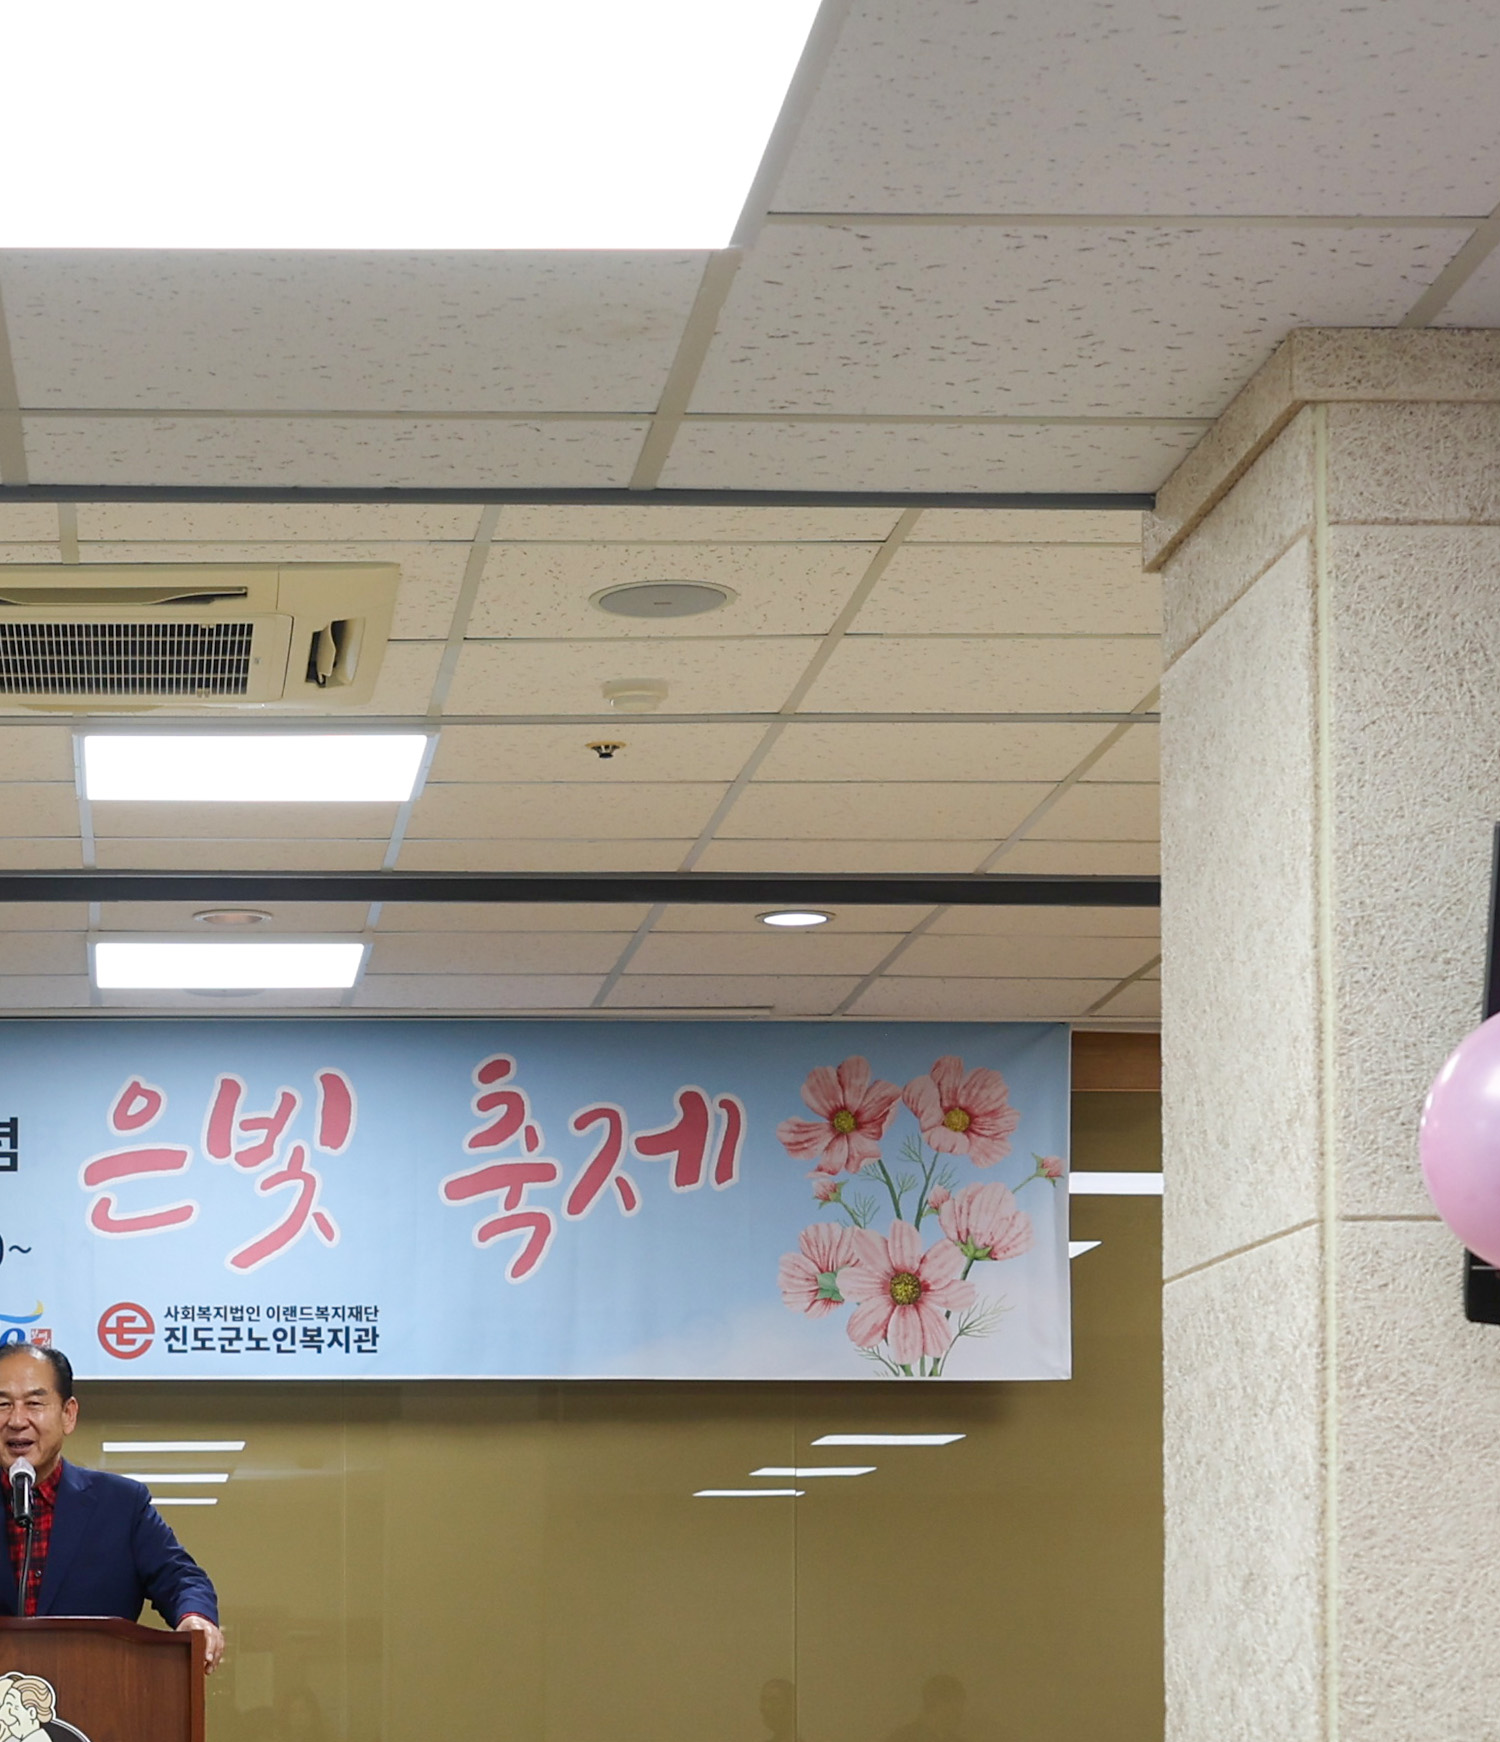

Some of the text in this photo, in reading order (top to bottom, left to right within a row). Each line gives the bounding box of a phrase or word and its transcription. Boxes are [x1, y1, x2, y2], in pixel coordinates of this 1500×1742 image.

[83, 1072, 351, 1270] 은빛
[444, 1058, 742, 1279] 축제
[163, 1305, 379, 1322] 사회복지법인 이랜드복지재단
[163, 1325, 380, 1354] 진도군노인복지관
